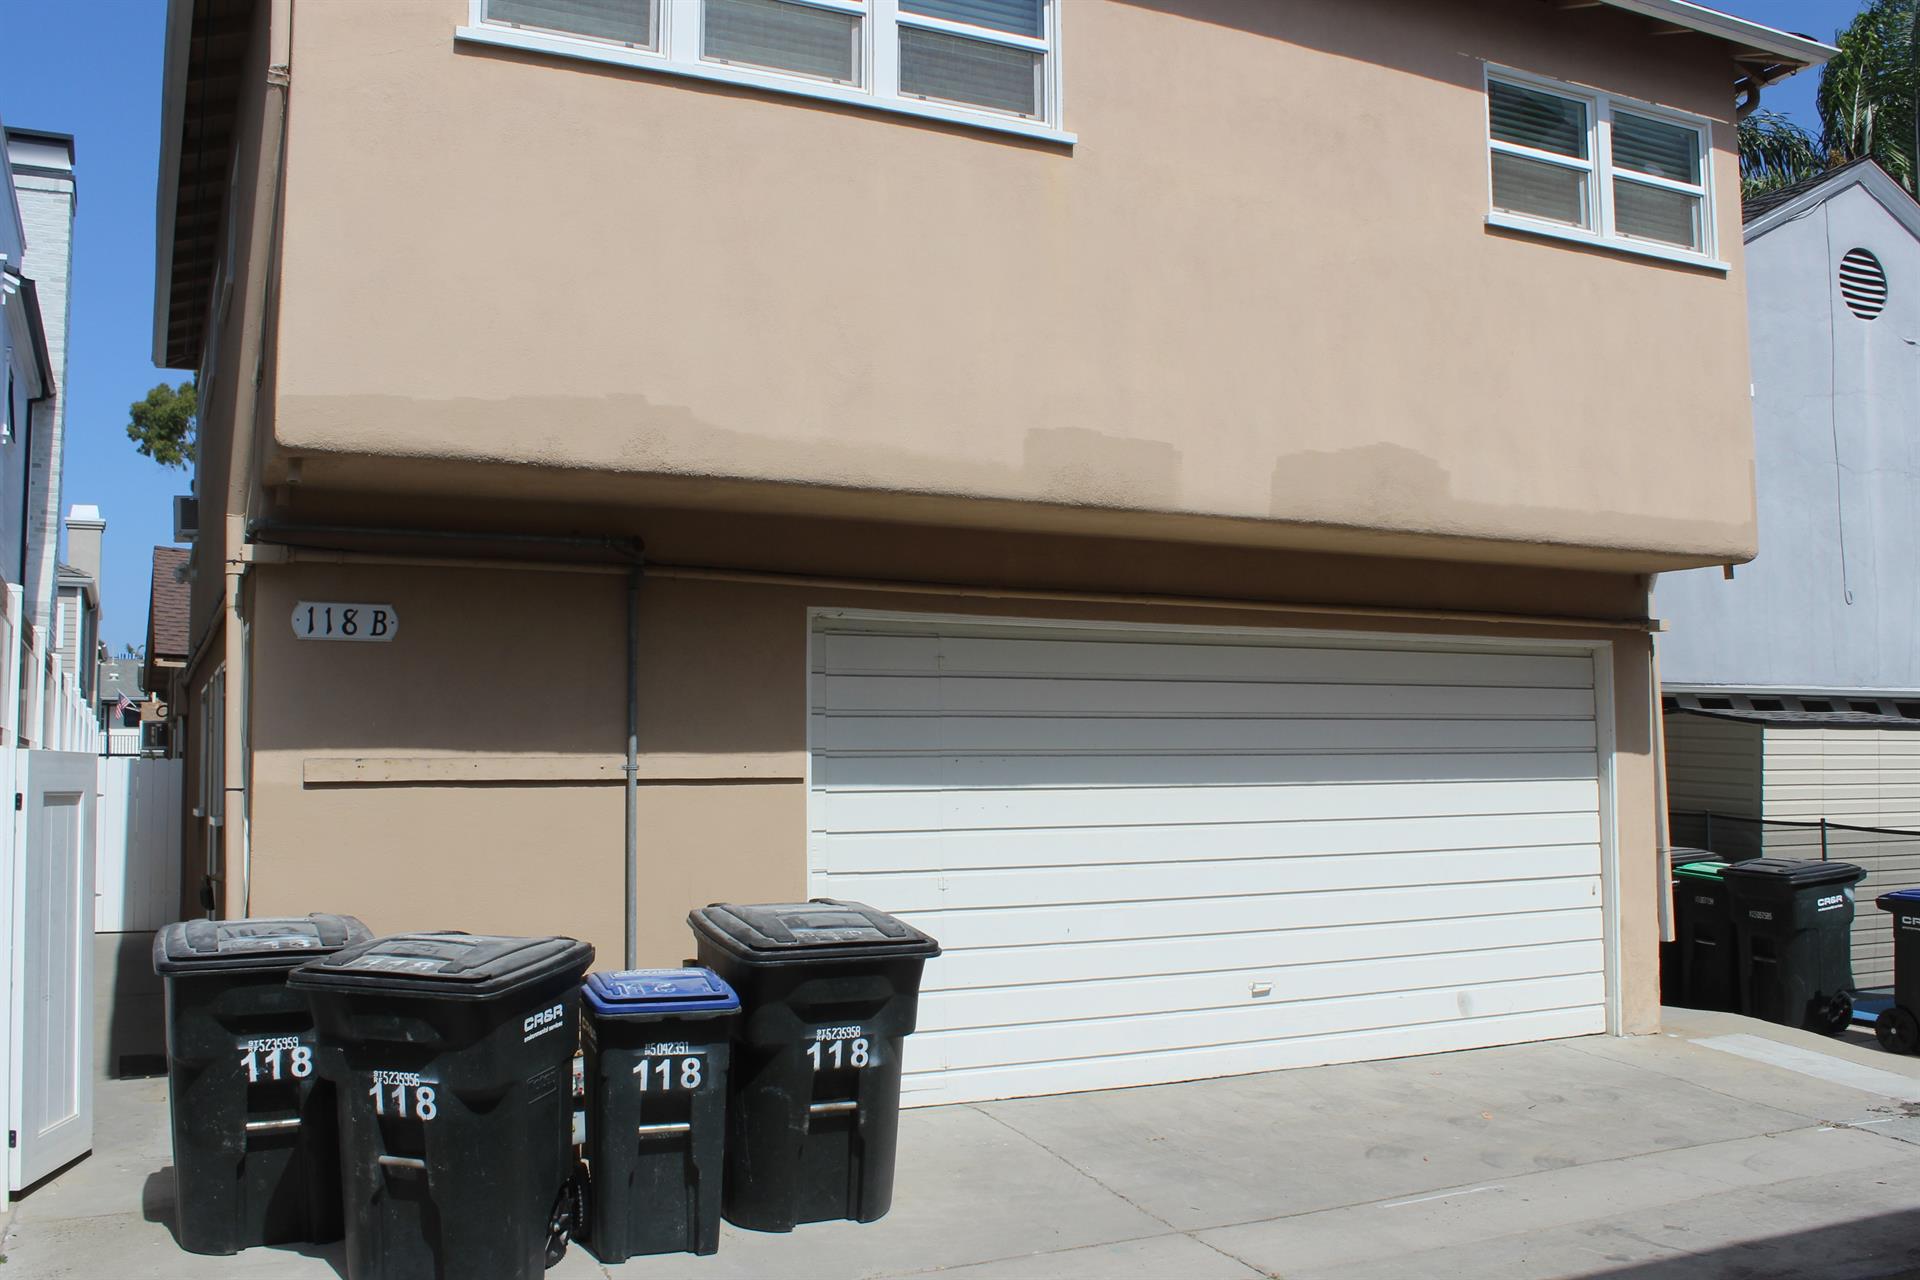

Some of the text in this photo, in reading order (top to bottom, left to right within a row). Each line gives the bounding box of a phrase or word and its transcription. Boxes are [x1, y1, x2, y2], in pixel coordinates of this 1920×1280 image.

[308, 606, 387, 636] 118 B
[1817, 895, 1843, 906] CR&R
[524, 1003, 563, 1032] CR&R
[241, 1046, 313, 1082] 118
[807, 1038, 869, 1071] 118
[632, 1057, 702, 1091] 118
[369, 1082, 437, 1121] 118
